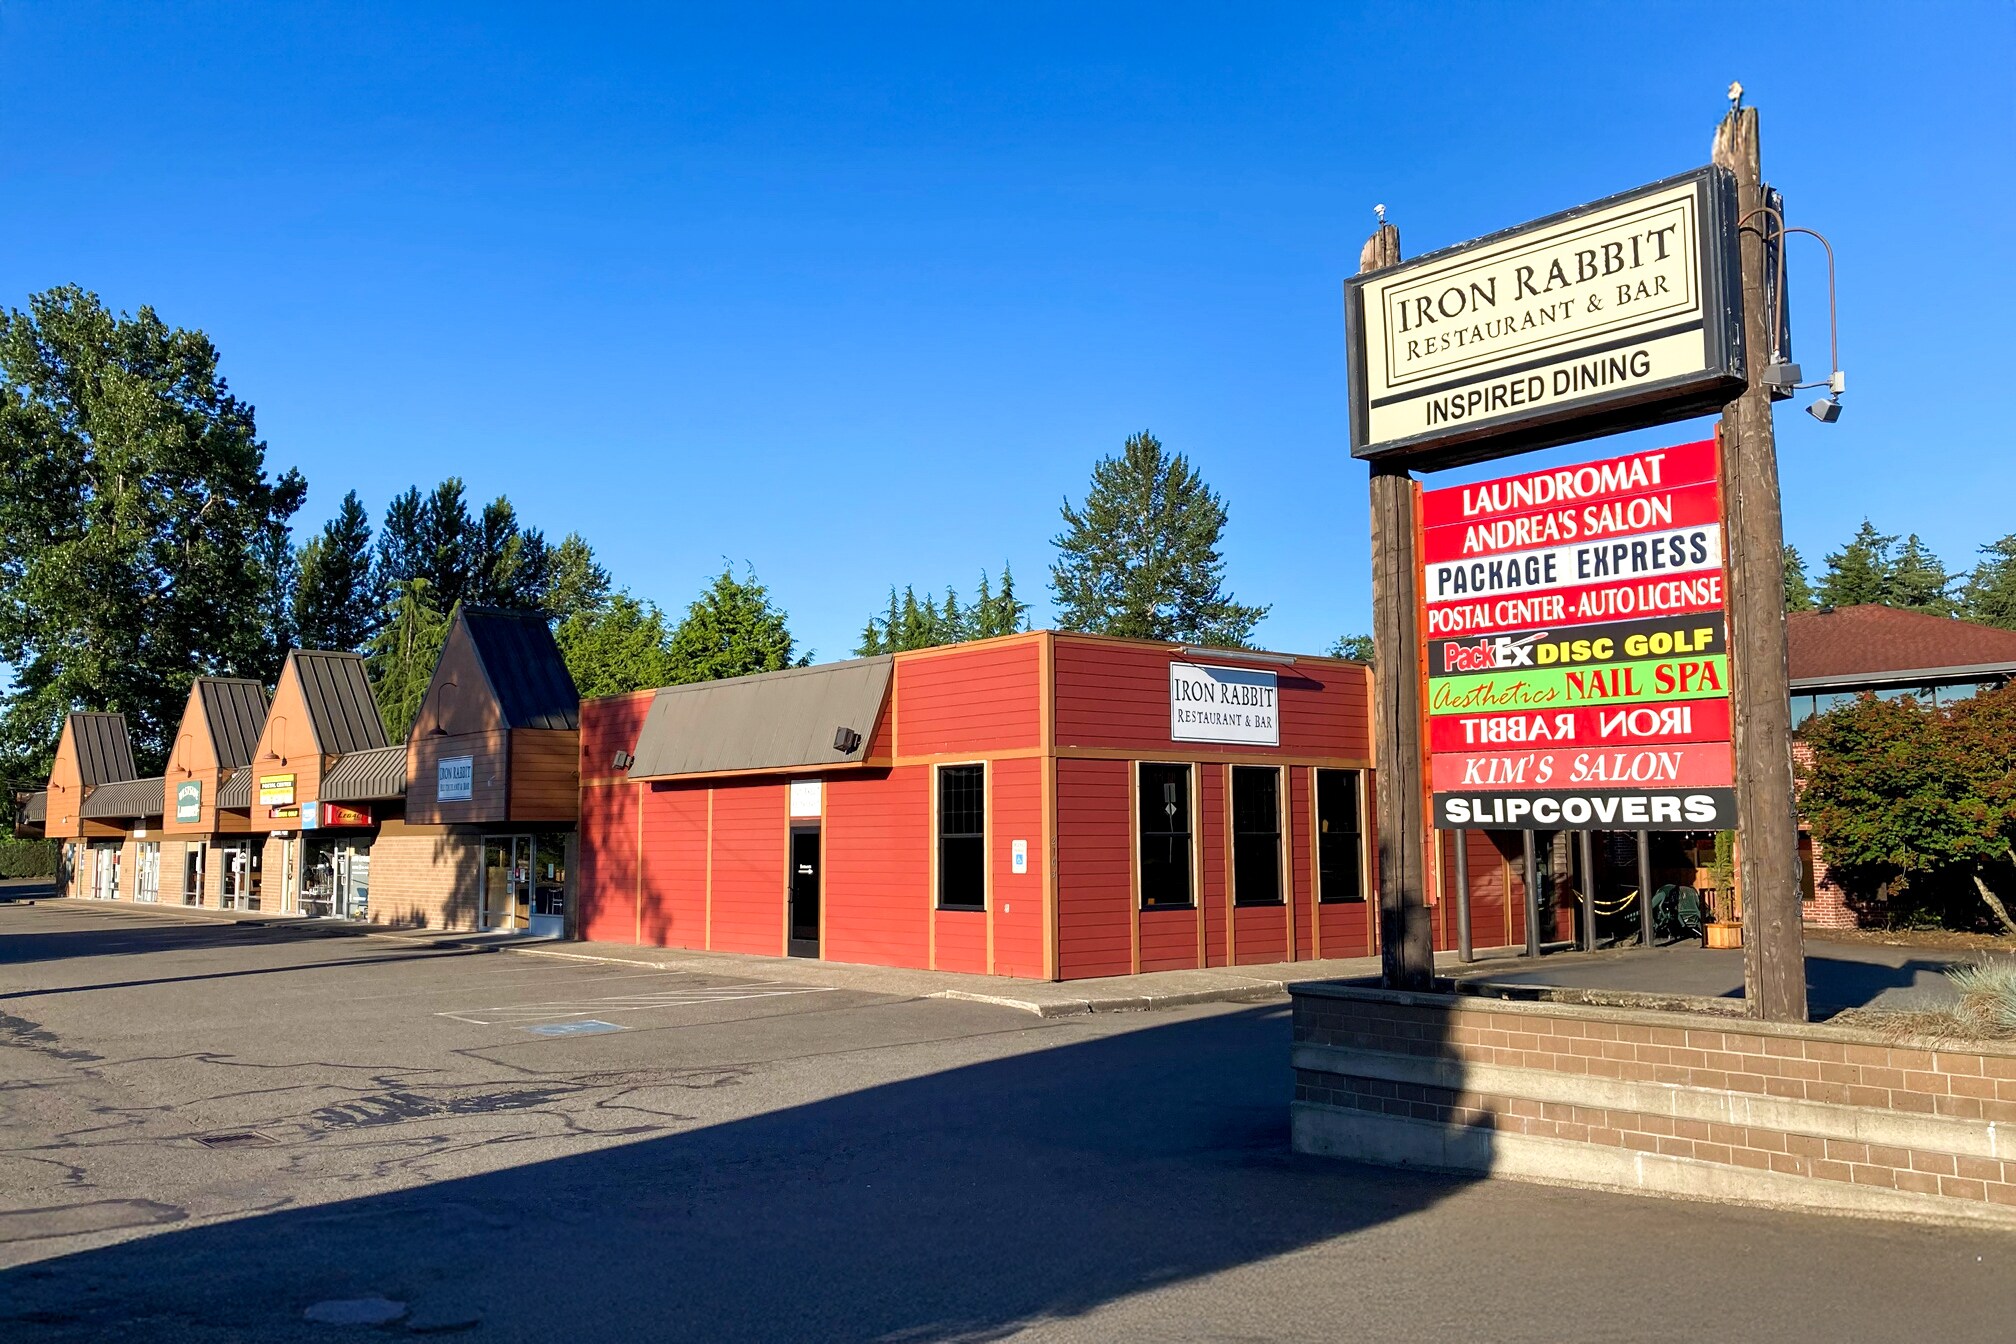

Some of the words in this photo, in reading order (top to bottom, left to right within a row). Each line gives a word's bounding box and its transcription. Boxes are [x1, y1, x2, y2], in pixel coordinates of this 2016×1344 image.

[1397, 276, 1496, 333] IRON
[1514, 222, 1677, 300] RABBIT
[1406, 298, 1576, 361] RESTAURANT
[1586, 294, 1604, 313] &
[1616, 274, 1670, 307] BAR
[1426, 375, 1545, 425] INSPIRED
[1553, 350, 1651, 397] DINING
[1463, 453, 1665, 516] LAUNDROMAT
[1462, 510, 1577, 554] ANDREA'S
[1584, 494, 1672, 535] SALON
[1438, 553, 1557, 596] PACKAGE
[1577, 532, 1707, 580] EXPRESS
[1429, 604, 1494, 633] POSTAL
[1495, 594, 1566, 627] CENTER
[1577, 587, 1635, 618] AUTO
[1638, 576, 1721, 611] LICENSE
[1444, 636, 1535, 672] PackEx
[1537, 639, 1613, 665] DISC
[1624, 628, 1714, 656] GOLF
[1174, 679, 1214, 703] IRON
[1220, 683, 1273, 707] RABBIT
[1433, 681, 1561, 711] Aesthetics
[1564, 667, 1643, 701] NAIL
[1655, 660, 1722, 695] SPA
[1177, 708, 1242, 726] RESTAURANT
[1245, 715, 1251, 727] &
[1255, 715, 1272, 728] BAR
[1461, 753, 1554, 785] KIM'S
[1569, 751, 1683, 782] SALON
[1445, 794, 1717, 824] SLIPCOVERS
